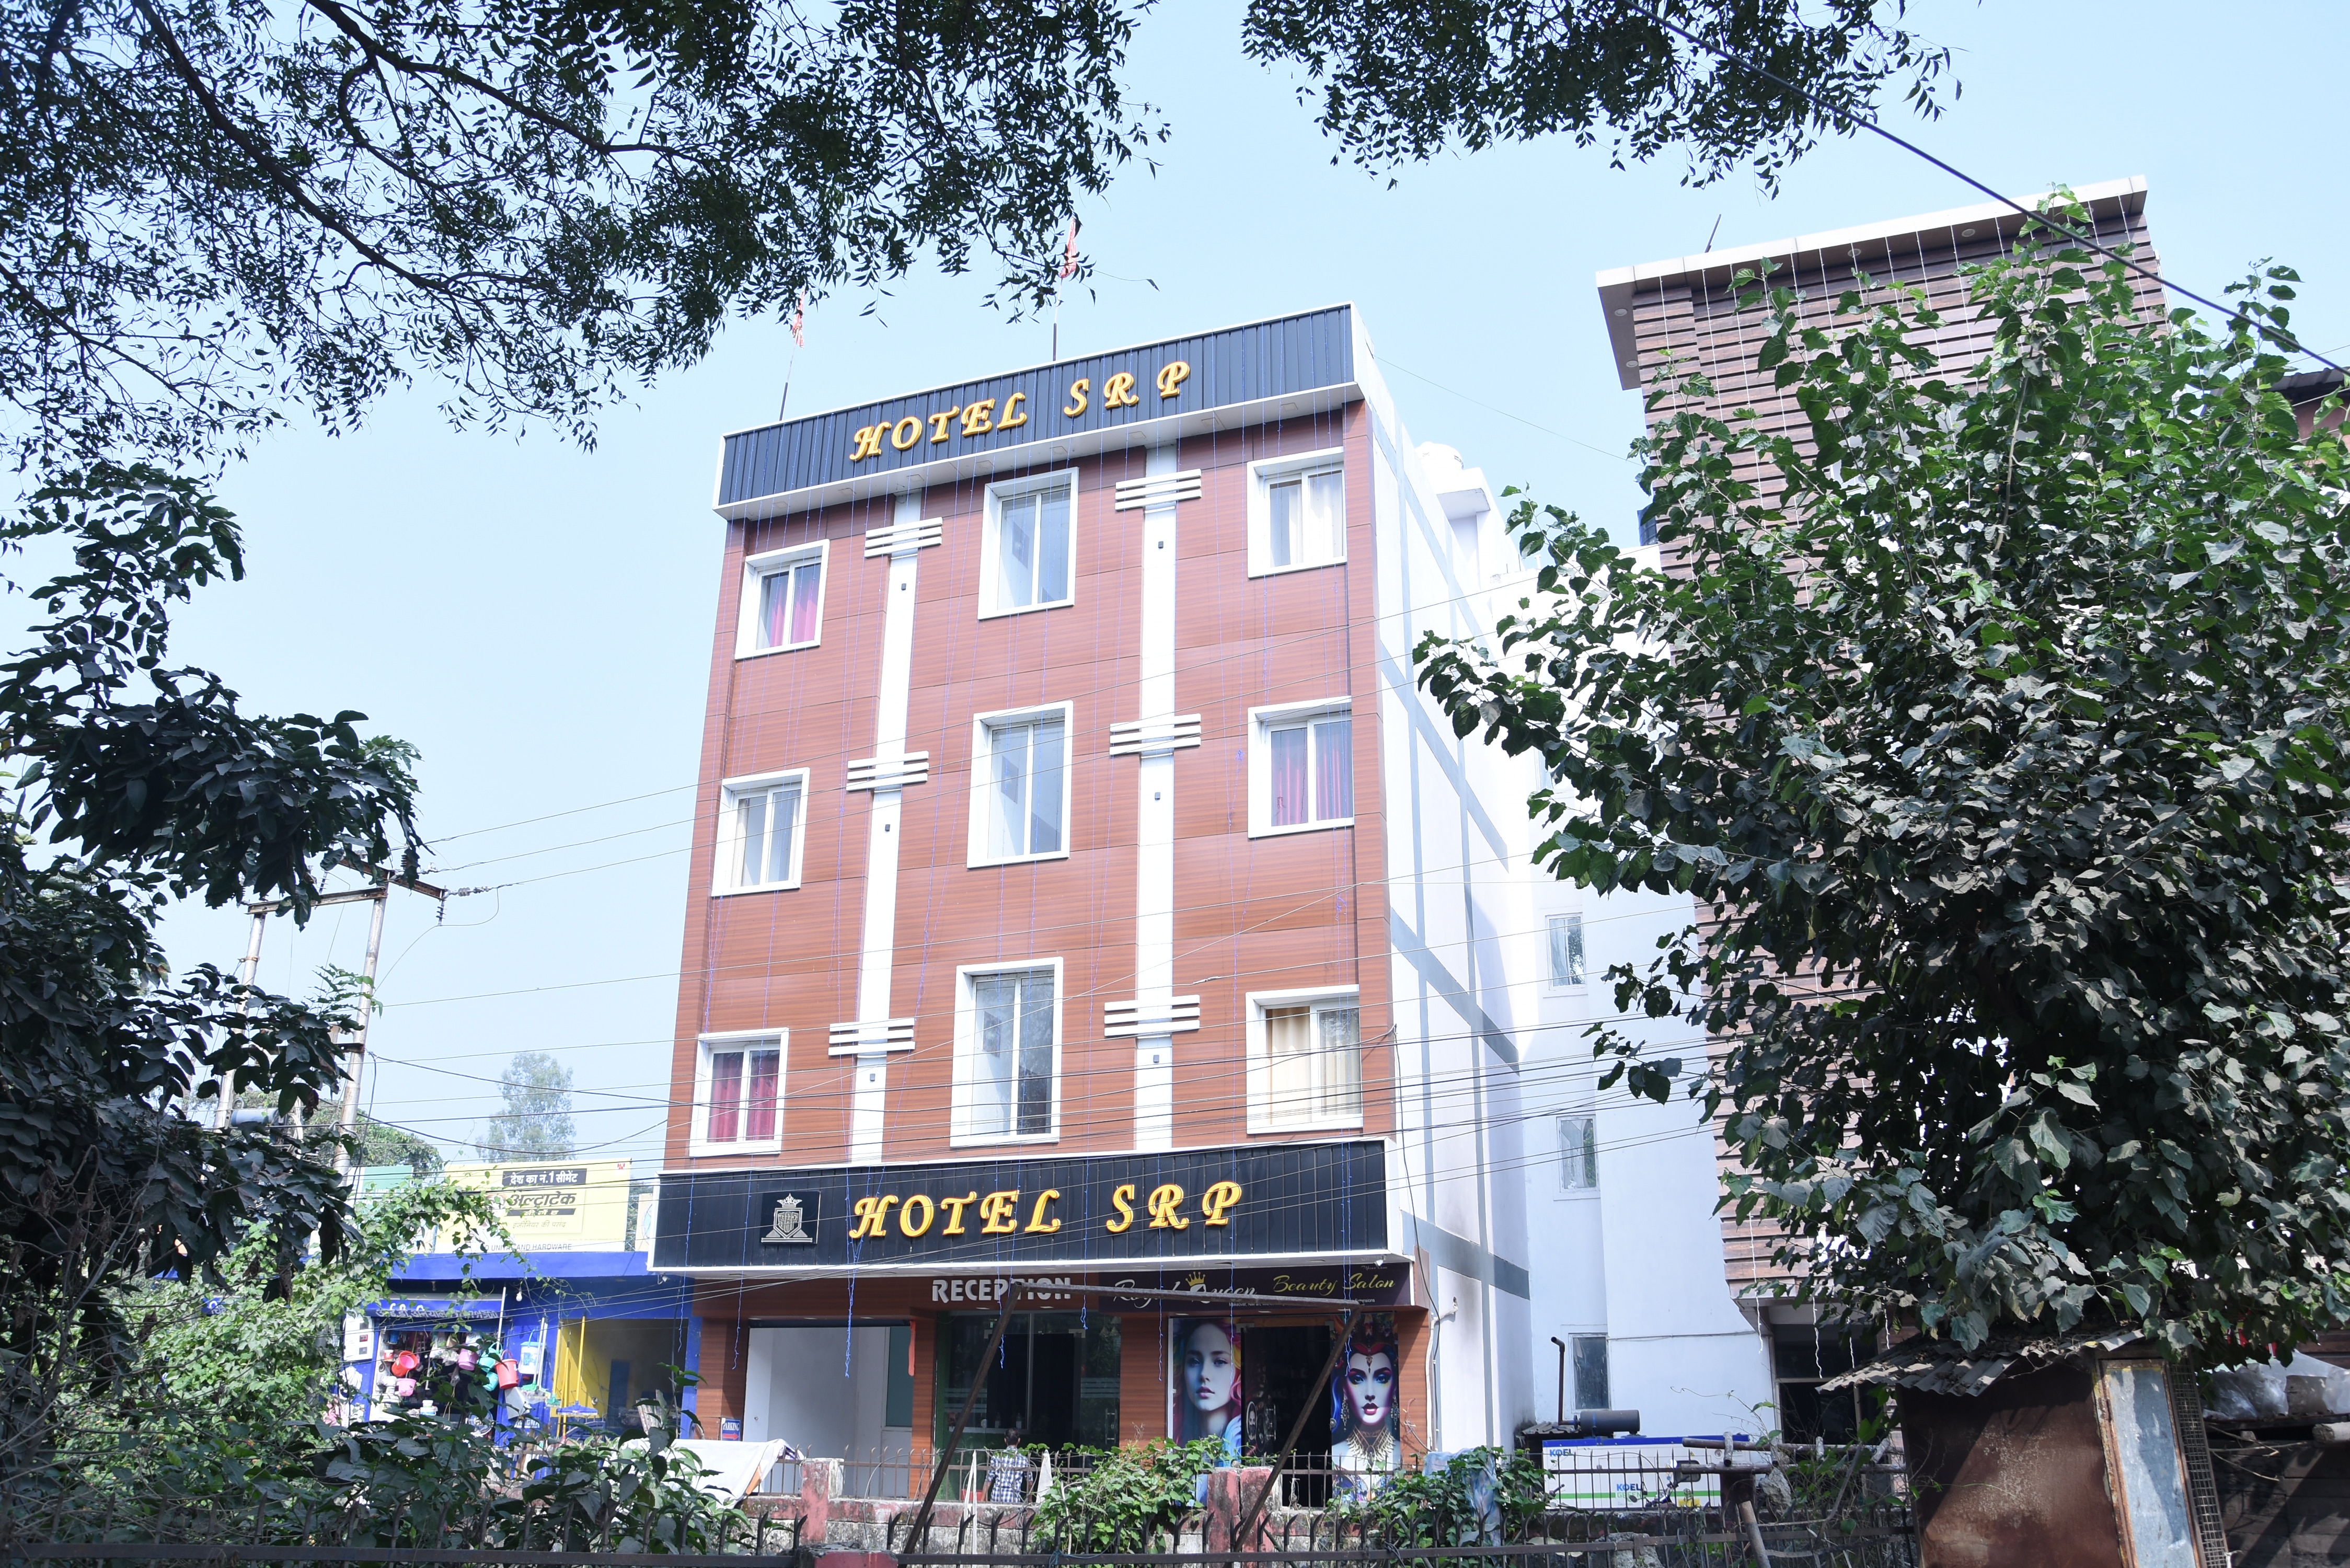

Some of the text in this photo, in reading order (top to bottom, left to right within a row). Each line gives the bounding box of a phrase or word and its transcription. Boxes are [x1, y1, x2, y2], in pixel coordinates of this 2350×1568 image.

[849, 392, 1027, 462] HOTEL
[526, 1174, 537, 1183] का
[556, 1170, 578, 1183] सीमेंट
[849, 1189, 1061, 1239] HOTEL
[1113, 1279, 1181, 1308] Royl
[1273, 1275, 1338, 1296] Beauty
[1342, 1273, 1396, 1290] Salon
[723, 1422, 740, 1431] PARKING
[1550, 1448, 1571, 1457] KOEL
